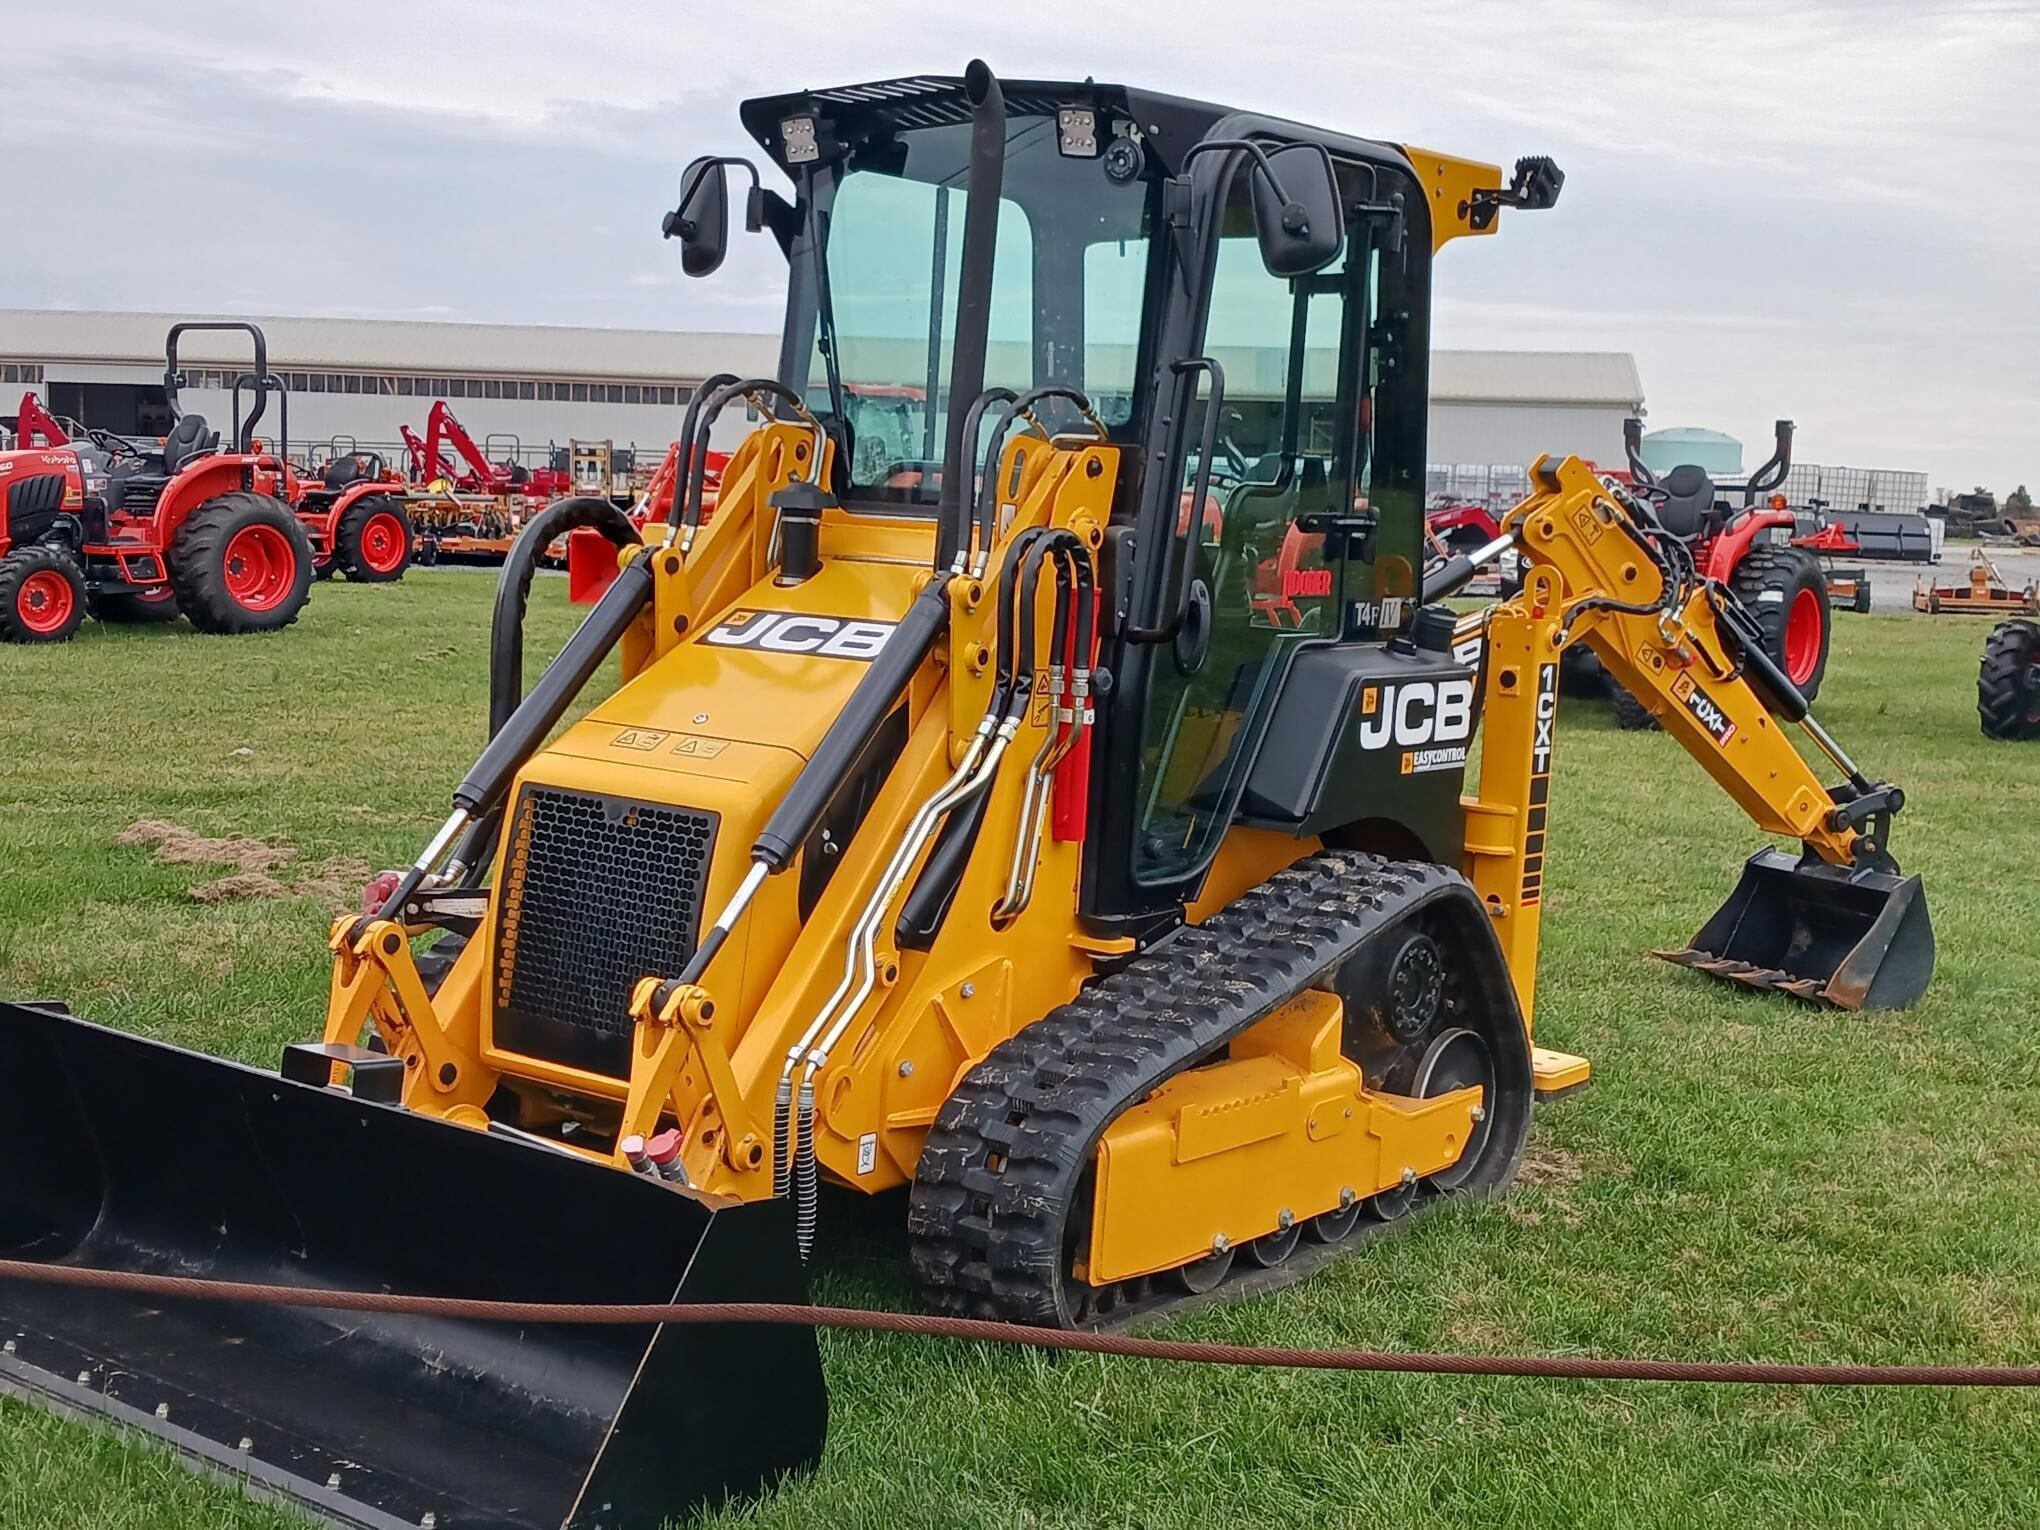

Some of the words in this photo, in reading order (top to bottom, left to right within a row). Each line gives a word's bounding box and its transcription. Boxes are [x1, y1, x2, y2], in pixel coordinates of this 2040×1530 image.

[41, 455, 76, 465] Kubota
[707, 614, 898, 657] JCB
[1360, 679, 1474, 749] JCB
[1534, 665, 1554, 773] 1CXT
[1413, 746, 1466, 769] EASYCONTROL
